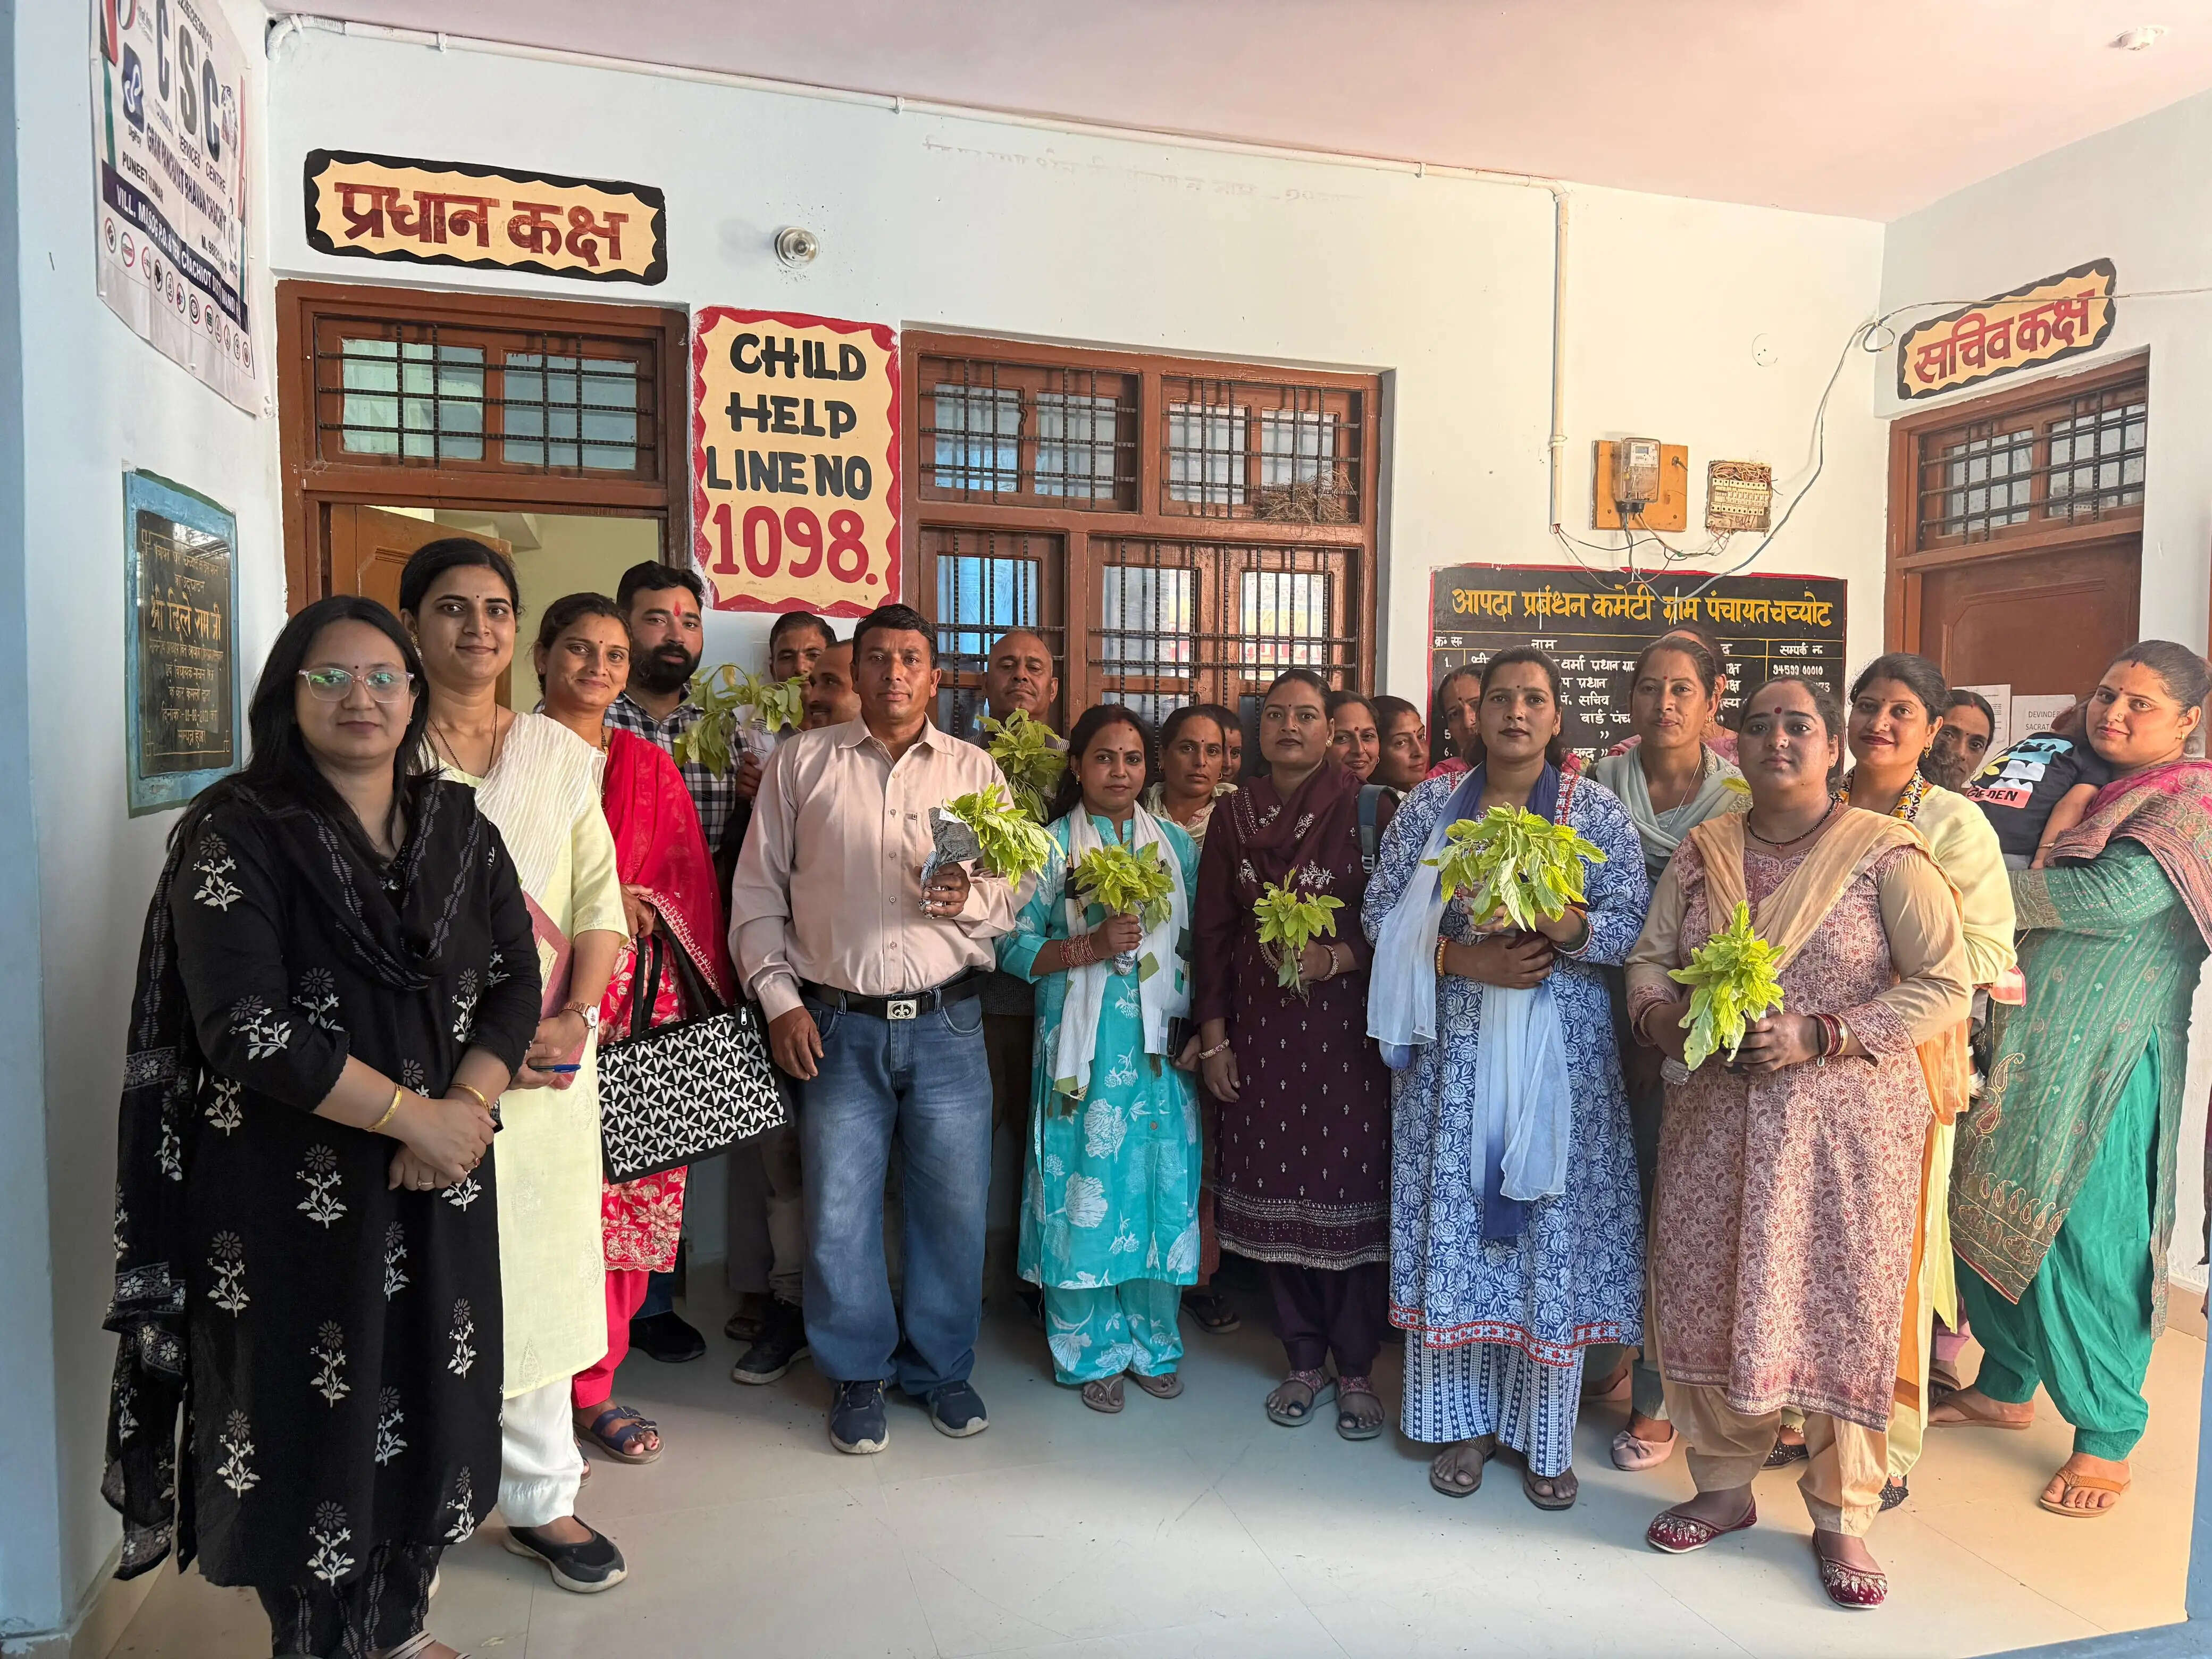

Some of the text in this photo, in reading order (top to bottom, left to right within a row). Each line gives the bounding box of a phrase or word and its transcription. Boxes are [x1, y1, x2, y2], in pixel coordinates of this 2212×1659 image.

[122, 152, 148, 185] PUNEET
[206, 161, 226, 195] CENTRE
[334, 182, 629, 267] प्रधान कक्ष
[1914, 289, 2096, 383] सचिव कक्ष
[730, 333, 867, 381] CHILD
[725, 392, 857, 439] HELP
[712, 503, 878, 585] 1098.
[1452, 584, 1833, 627] आपदा प्रबंधन कमेटी ग्राम पंचायत चच्योट
[1561, 655, 1586, 671] वर्मा
[1590, 659, 1621, 672] प्रधान
[1780, 642, 1808, 656] सम्पर्क
[1576, 677, 1608, 689] प्रधान
[1578, 691, 1610, 706] सचिव
[1579, 708, 1607, 724] वार्ड
